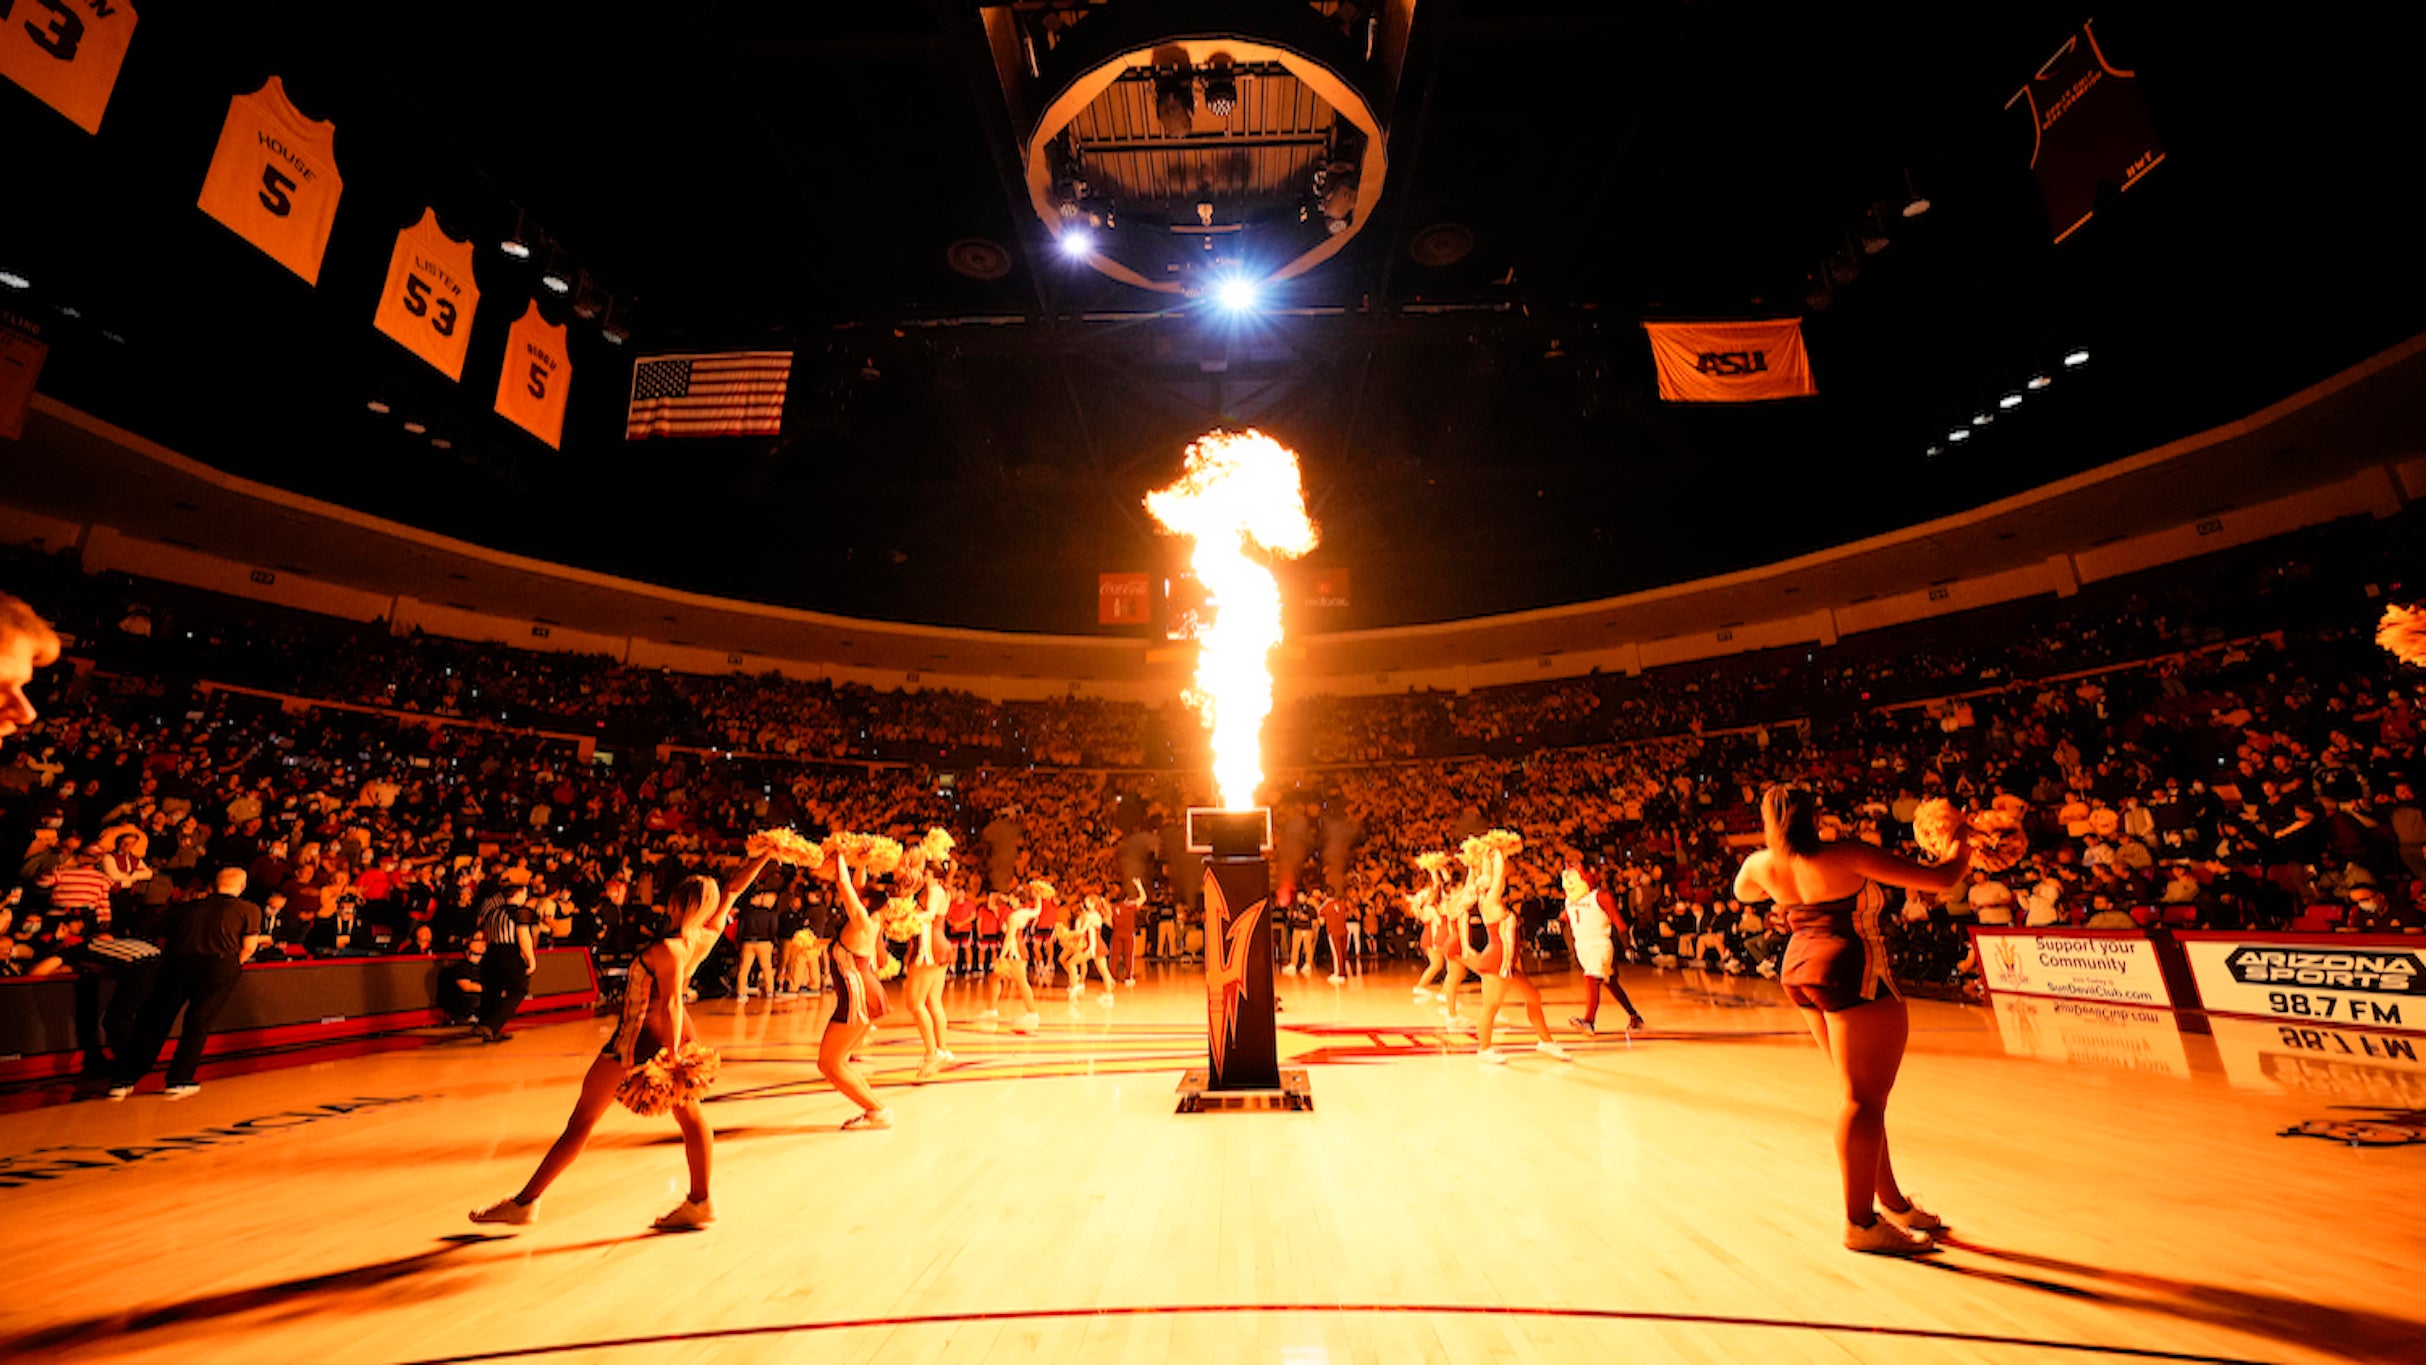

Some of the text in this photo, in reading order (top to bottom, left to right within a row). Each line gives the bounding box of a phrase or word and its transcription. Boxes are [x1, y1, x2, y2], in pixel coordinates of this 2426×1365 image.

[259, 131, 317, 183] HOUSE
[259, 163, 296, 217] 5
[416, 255, 461, 297] LISTER
[404, 272, 457, 337] 53
[1696, 351, 1770, 376] ASU
[527, 362, 548, 400] 5
[2036, 937, 2136, 955] Support your
[2039, 952, 2127, 973] Community
[2236, 951, 2418, 976] ARIZONA
[2047, 981, 2153, 1001] SunDevilClub.com
[2244, 965, 2410, 990] SPORTS
[2269, 991, 2402, 1024] 98.7 FM
